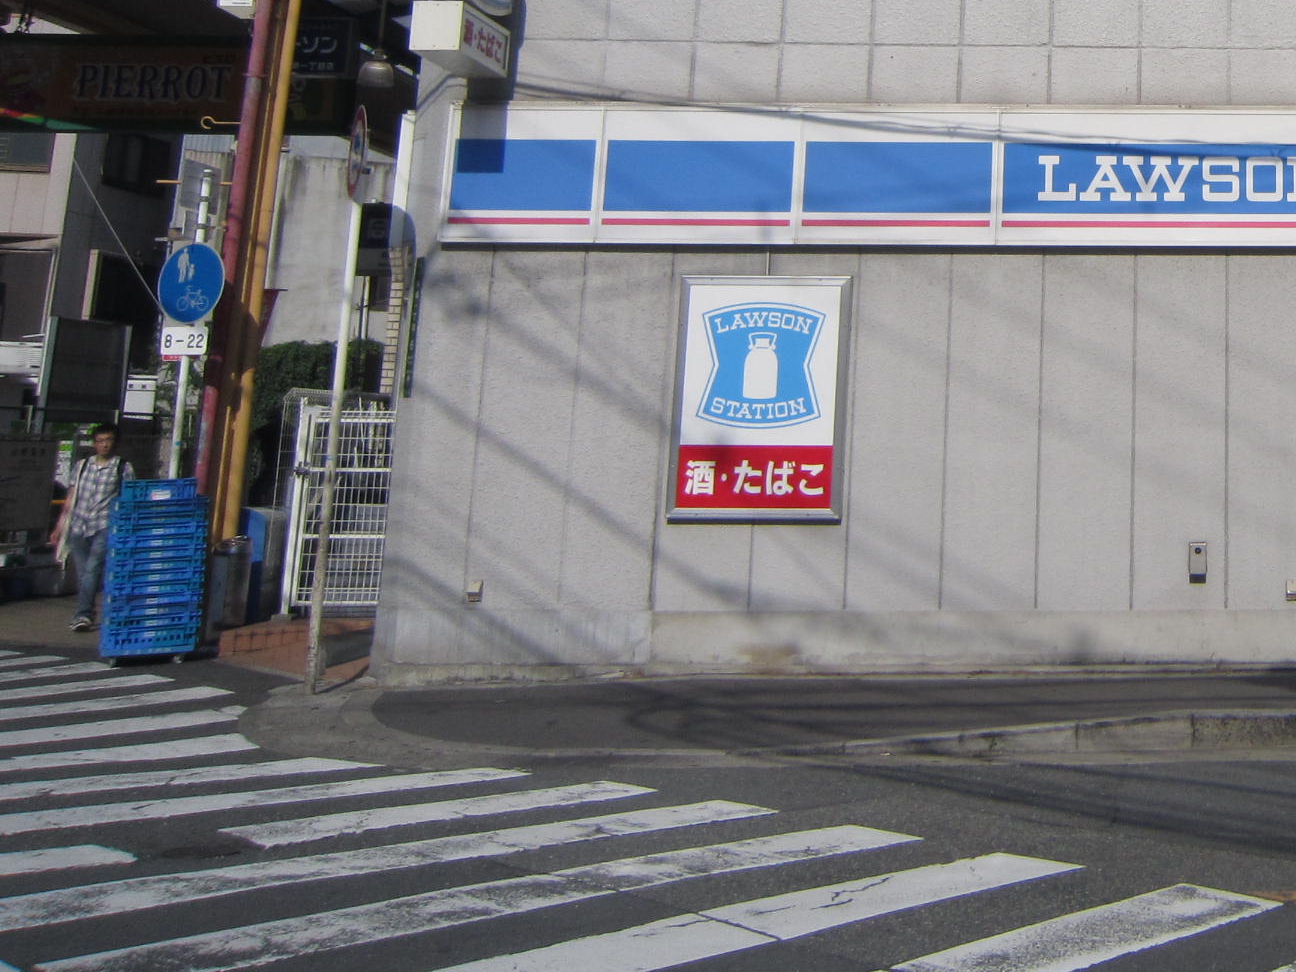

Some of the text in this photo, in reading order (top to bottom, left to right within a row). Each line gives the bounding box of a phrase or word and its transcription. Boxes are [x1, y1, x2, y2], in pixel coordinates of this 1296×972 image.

[75, 64, 231, 102] PIERROT
[714, 311, 813, 335] LAWSON
[710, 397, 807, 420] STATION
[684, 460, 824, 496] 酒・たばこ
